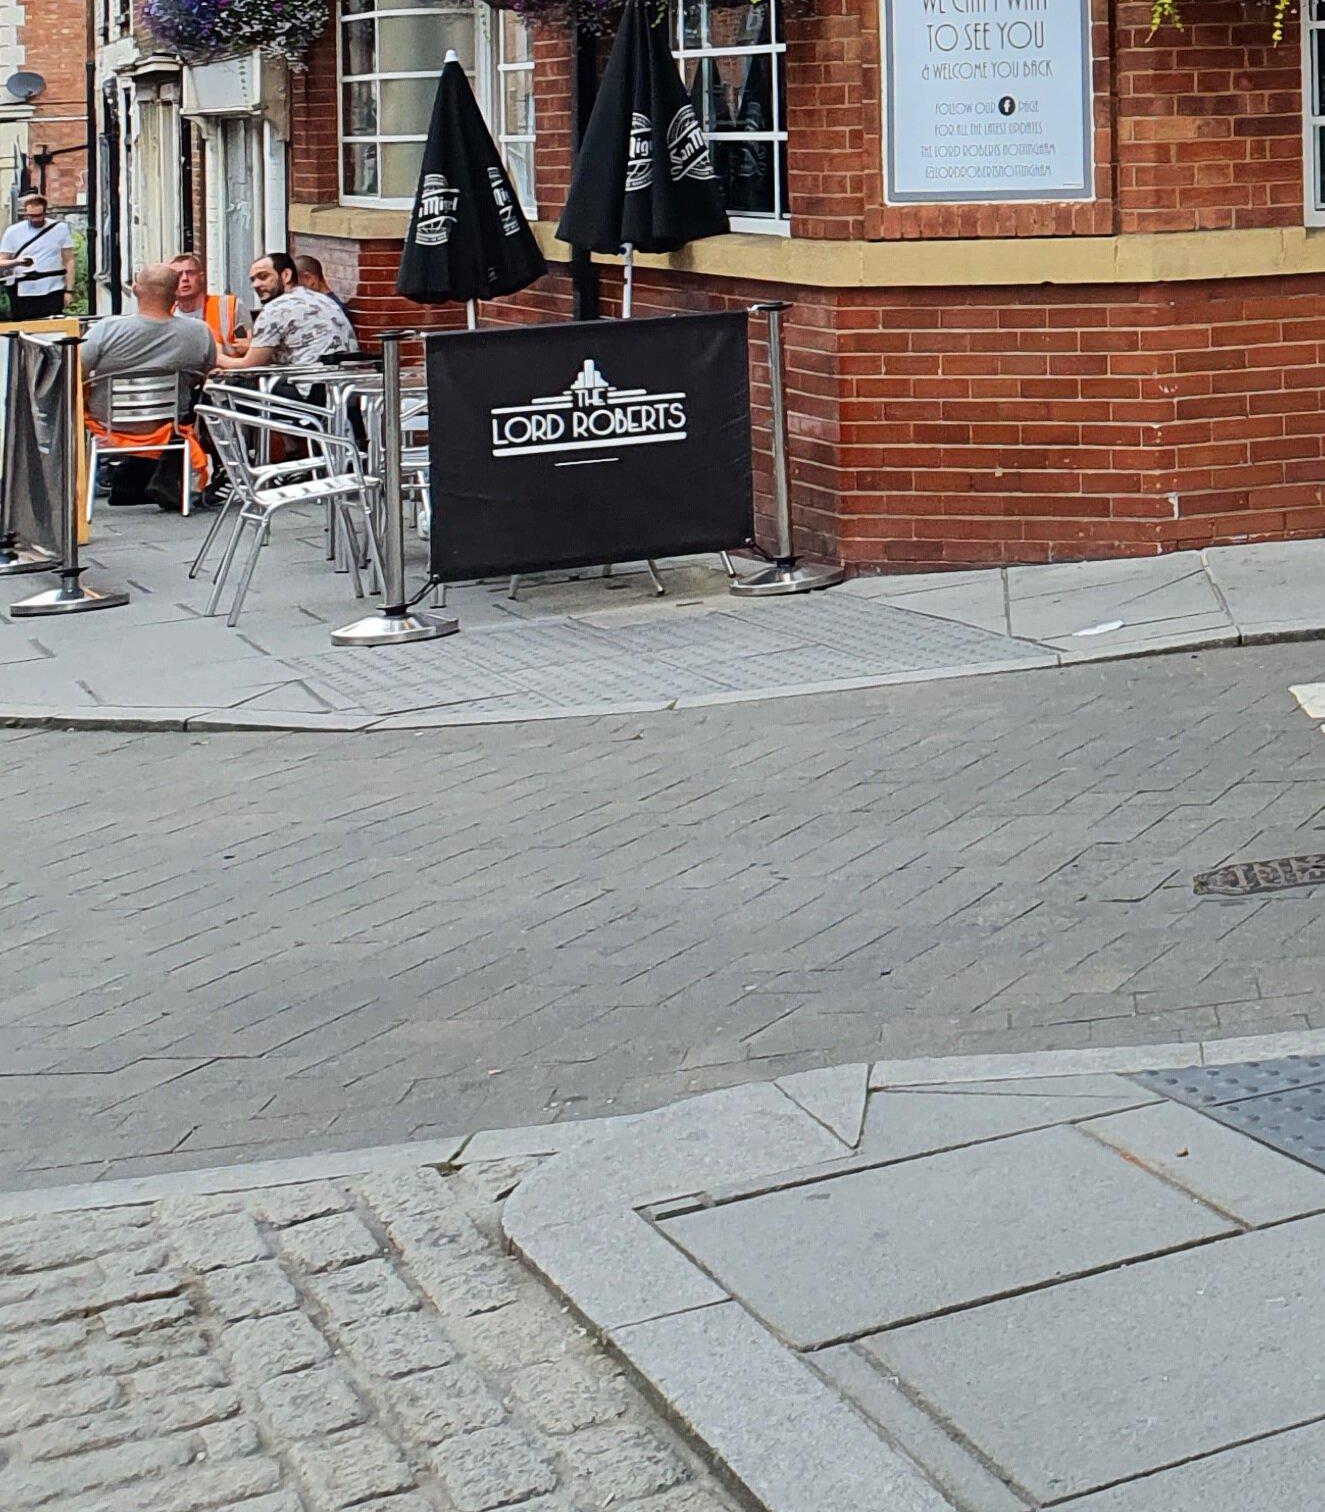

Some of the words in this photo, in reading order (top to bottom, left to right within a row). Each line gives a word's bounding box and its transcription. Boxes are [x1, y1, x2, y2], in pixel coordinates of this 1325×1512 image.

[926, 23, 959, 53] TO
[964, 22, 991, 51] SEE
[997, 21, 1045, 50] YOU
[932, 61, 989, 80] WELCOME
[990, 61, 1018, 79] YOU
[1023, 59, 1053, 77] BACK
[936, 102, 973, 116] FOLLOW
[975, 101, 996, 114] OUR
[1018, 100, 1039, 113] PAGE
[935, 124, 954, 136] FOR
[956, 123, 968, 136] ALL
[970, 123, 981, 135] THE
[984, 122, 1006, 135] LATEST
[1009, 121, 1043, 135] UPDATES
[920, 145, 932, 158] THE
[934, 145, 960, 157] LORD
[962, 144, 1000, 157] ROBERTS
[1003, 143, 1056, 156] NOTTINGHAM
[574, 388, 606, 407] THE
[492, 414, 565, 445] LORD
[573, 403, 686, 438] ROBERTS
